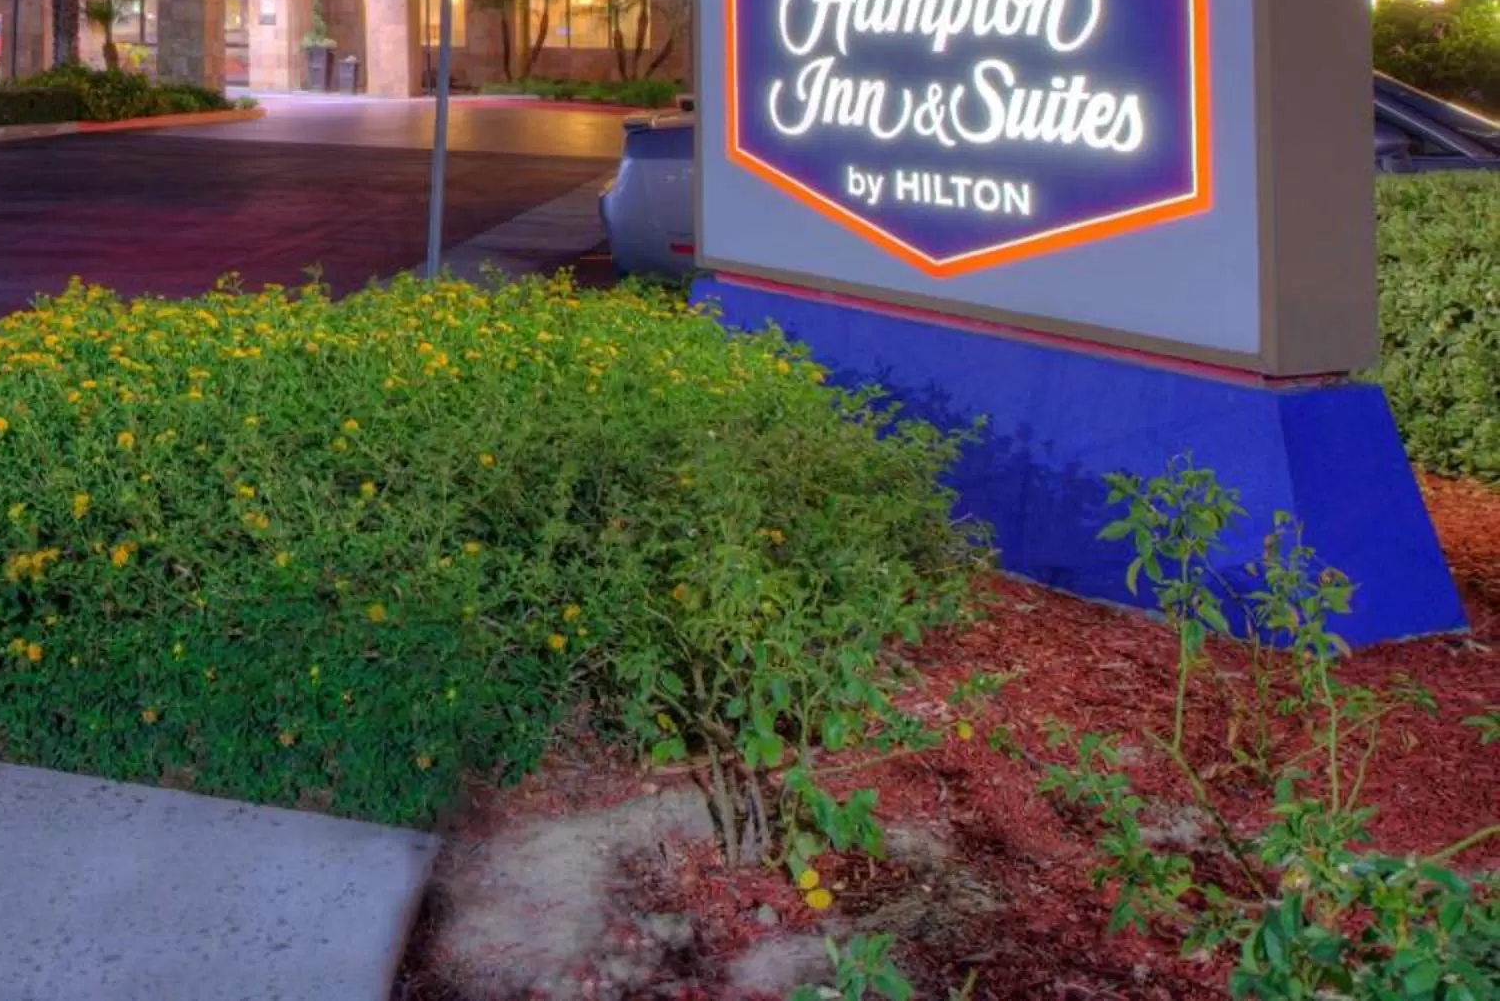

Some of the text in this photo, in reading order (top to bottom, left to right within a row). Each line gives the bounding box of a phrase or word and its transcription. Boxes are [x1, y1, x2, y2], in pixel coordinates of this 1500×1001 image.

[769, 55, 1143, 152] Inn & Suites
[847, 166, 1032, 216] by HILTON
